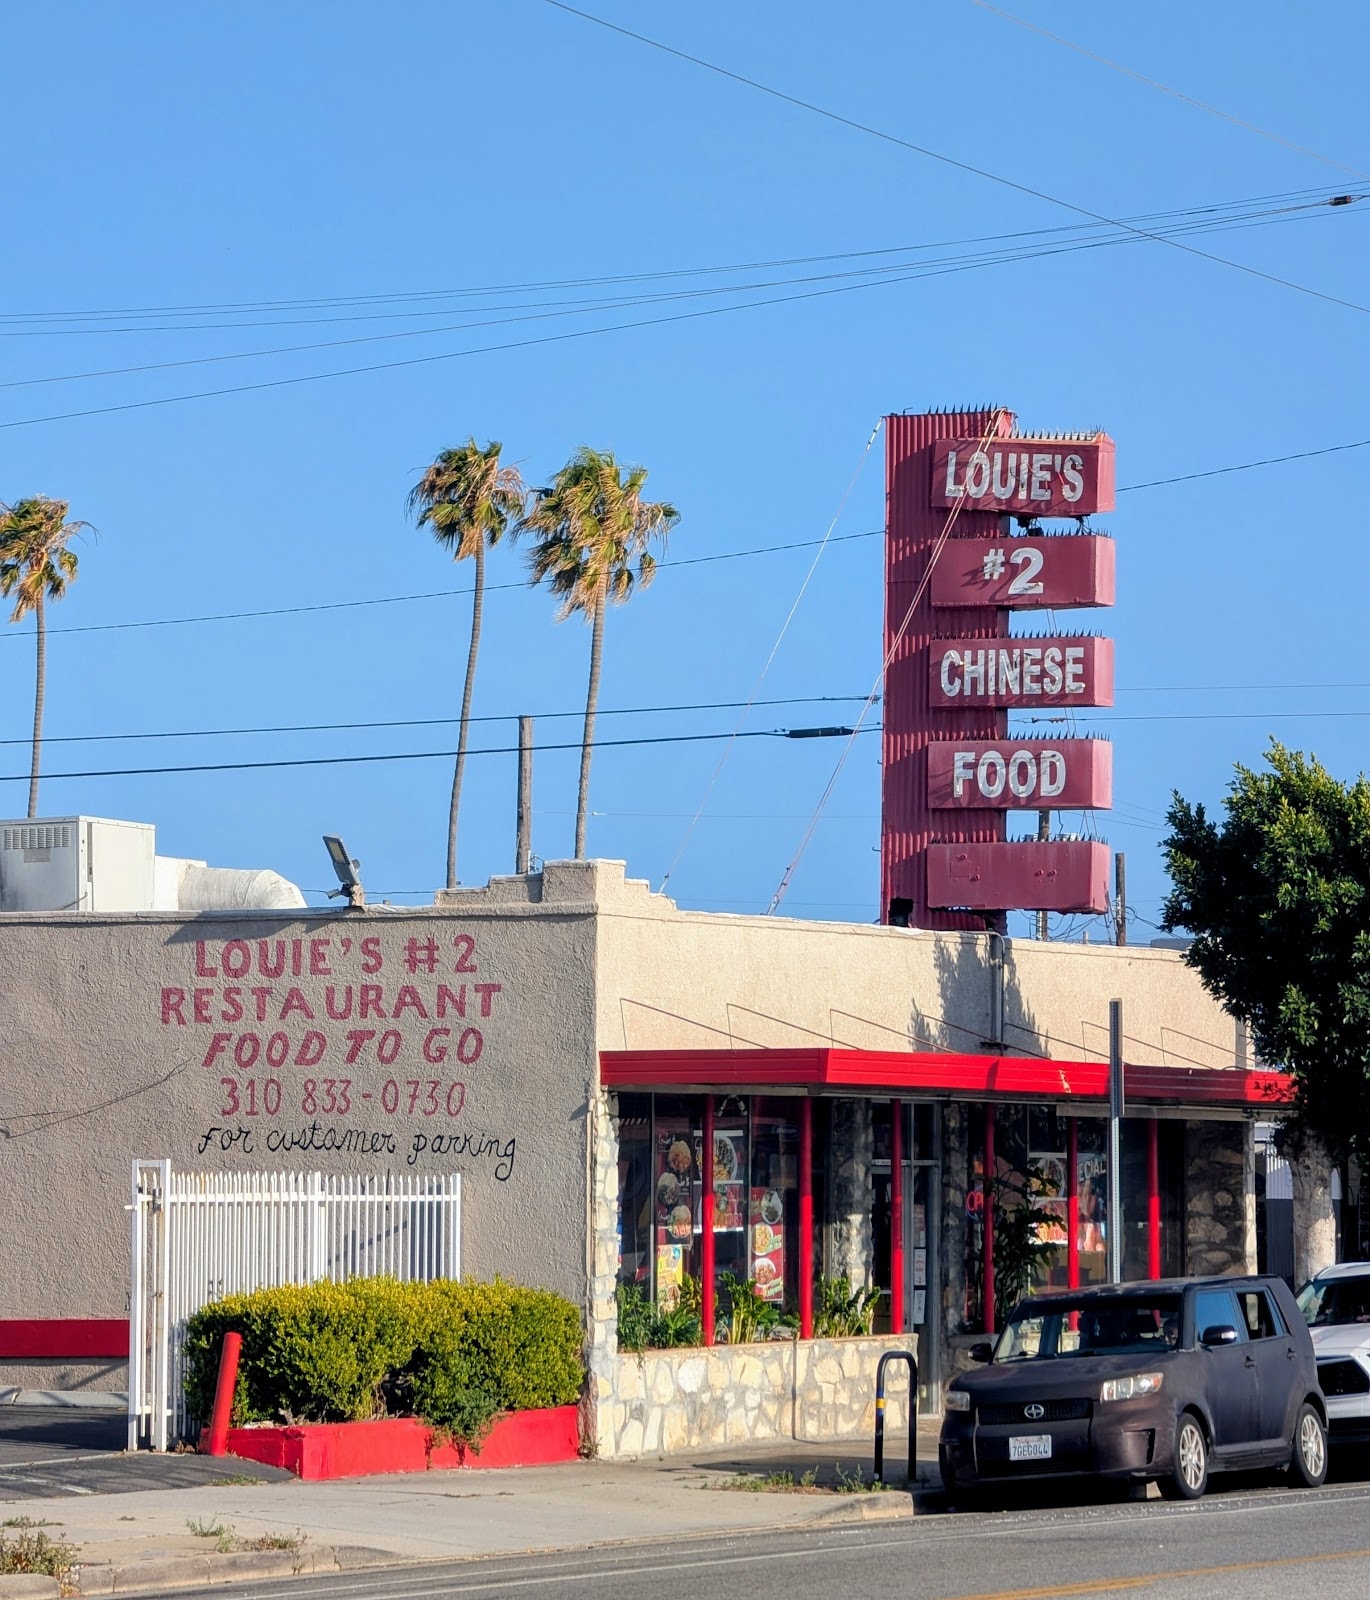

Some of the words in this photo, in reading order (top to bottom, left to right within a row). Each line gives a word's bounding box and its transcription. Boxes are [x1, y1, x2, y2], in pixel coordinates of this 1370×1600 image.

[944, 450, 1084, 502] LOUIE'S
[983, 547, 1044, 595] #2
[940, 647, 1085, 697] CHINESE
[953, 749, 1067, 798] FOOD
[195, 937, 383, 979] LOUIE'S
[160, 983, 502, 1025] RESTAURANT
[201, 1030, 328, 1069] FOOD
[345, 1028, 402, 1065] TO
[422, 1027, 484, 1065] GO
[220, 1077, 282, 1117] 310
[301, 1078, 466, 1118] 833-0730
[266, 1120, 396, 1153] customer
[407, 1132, 516, 1182] parking
[1078, 1156, 1107, 1182] ECIAL
